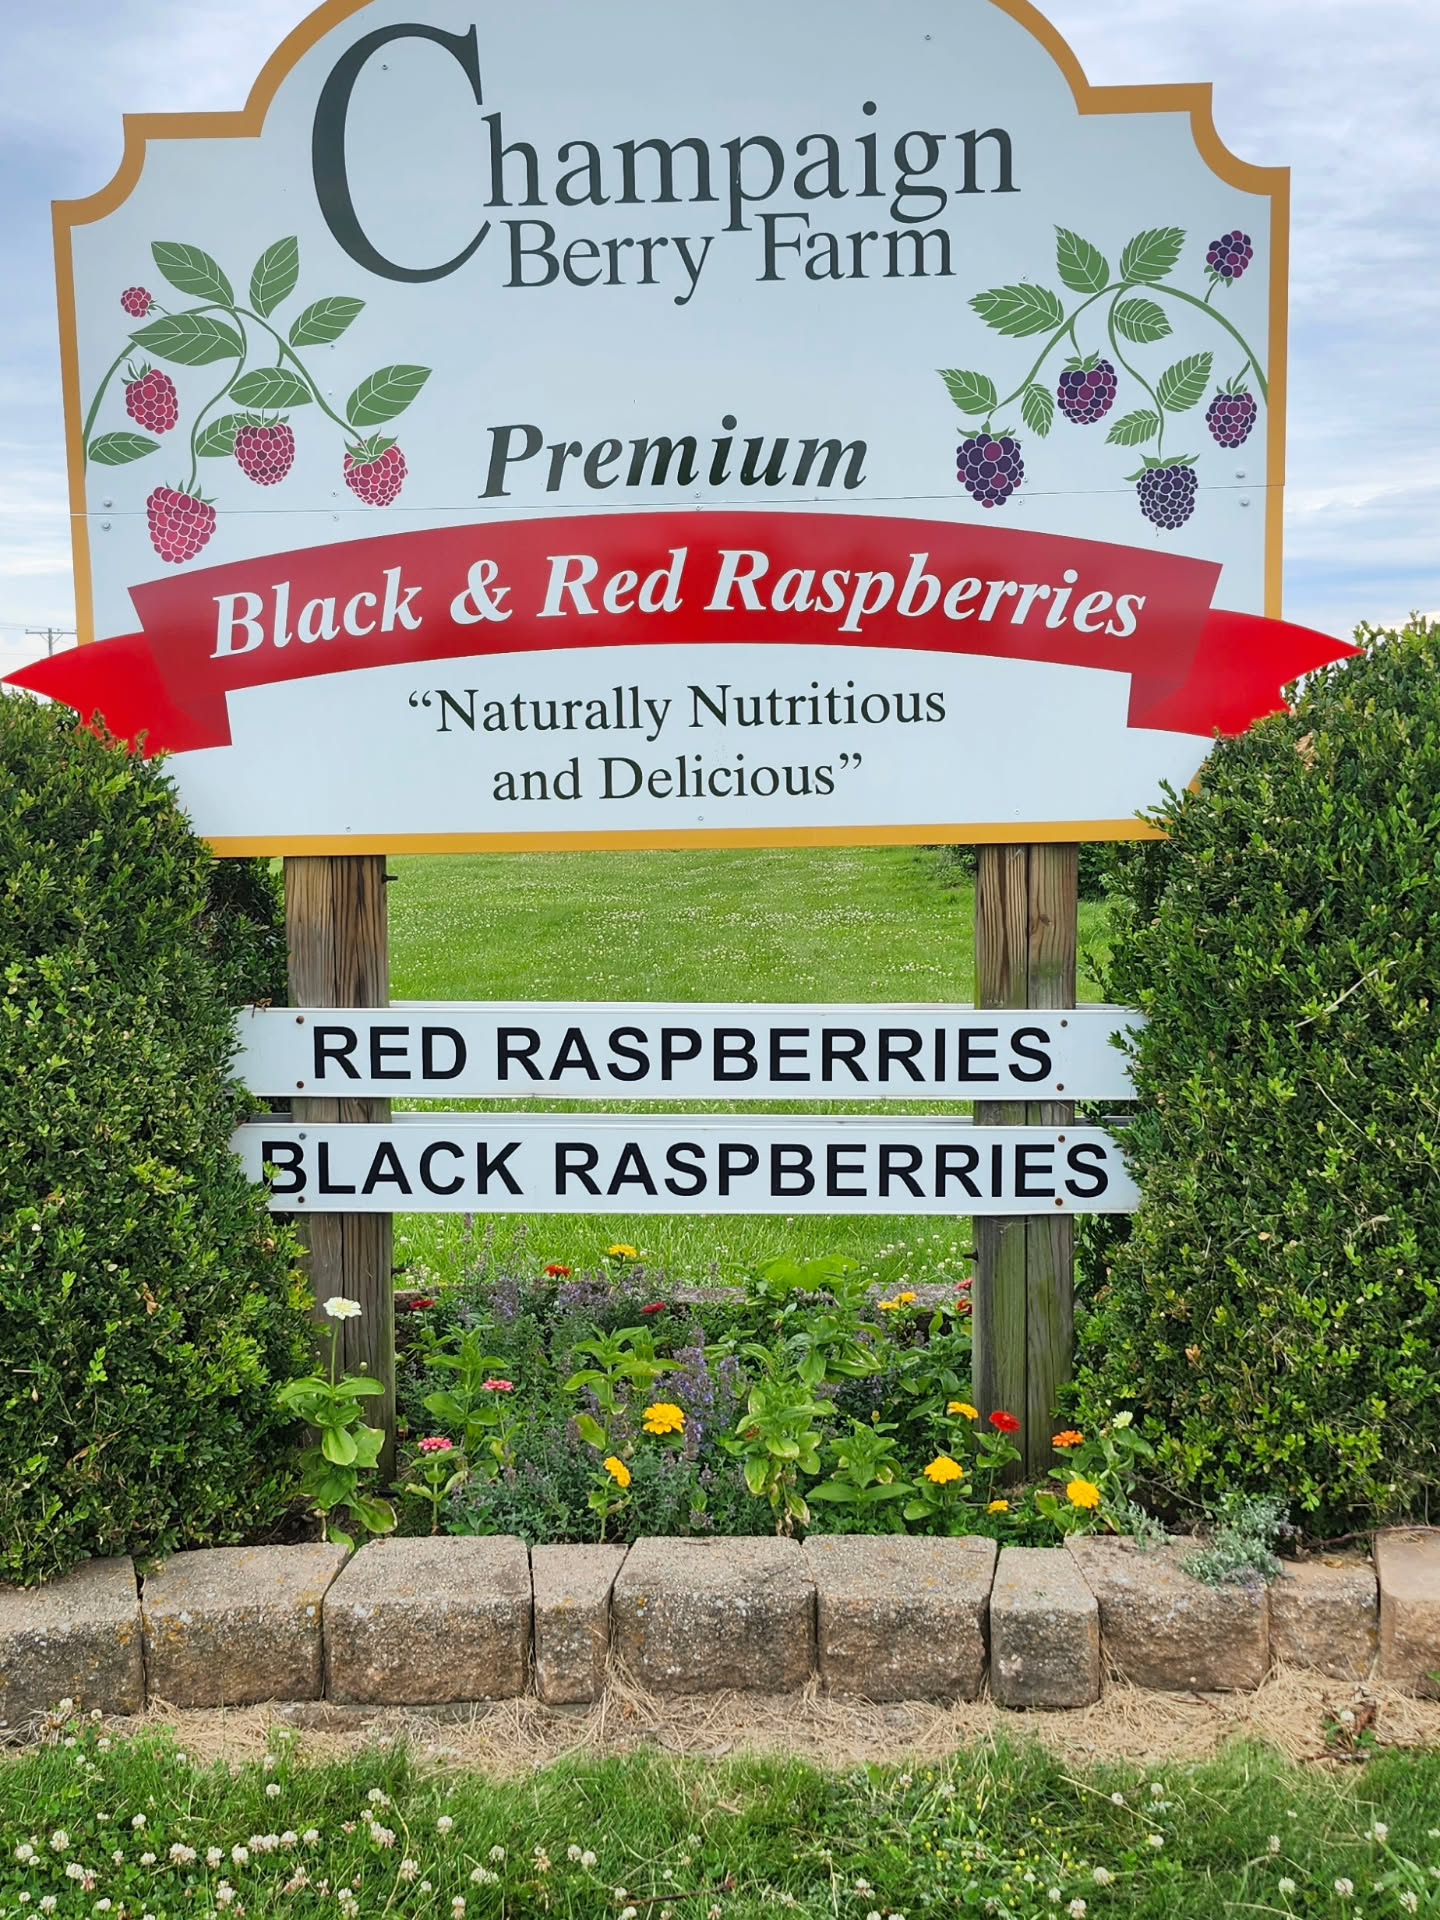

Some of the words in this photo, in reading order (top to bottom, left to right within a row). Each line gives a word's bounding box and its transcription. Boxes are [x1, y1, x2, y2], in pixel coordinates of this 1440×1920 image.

[312, 22, 1021, 283] Champaign
[502, 219, 714, 305] Berry
[755, 213, 956, 281] Farm
[478, 414, 868, 499] Premium
[210, 566, 422, 658] Black
[450, 559, 513, 625] &
[536, 546, 688, 618] Red
[704, 549, 1147, 637] Raspberries
[408, 685, 672, 741] “Naturally
[688, 681, 946, 728] Nutritious
[493, 757, 581, 801] and
[599, 752, 863, 800] Delicious”
[313, 1026, 467, 1079] RED
[497, 1027, 1052, 1083] RASPBERRIES
[262, 1140, 523, 1195] BLACK
[554, 1142, 1109, 1198] RASPBERRIES
